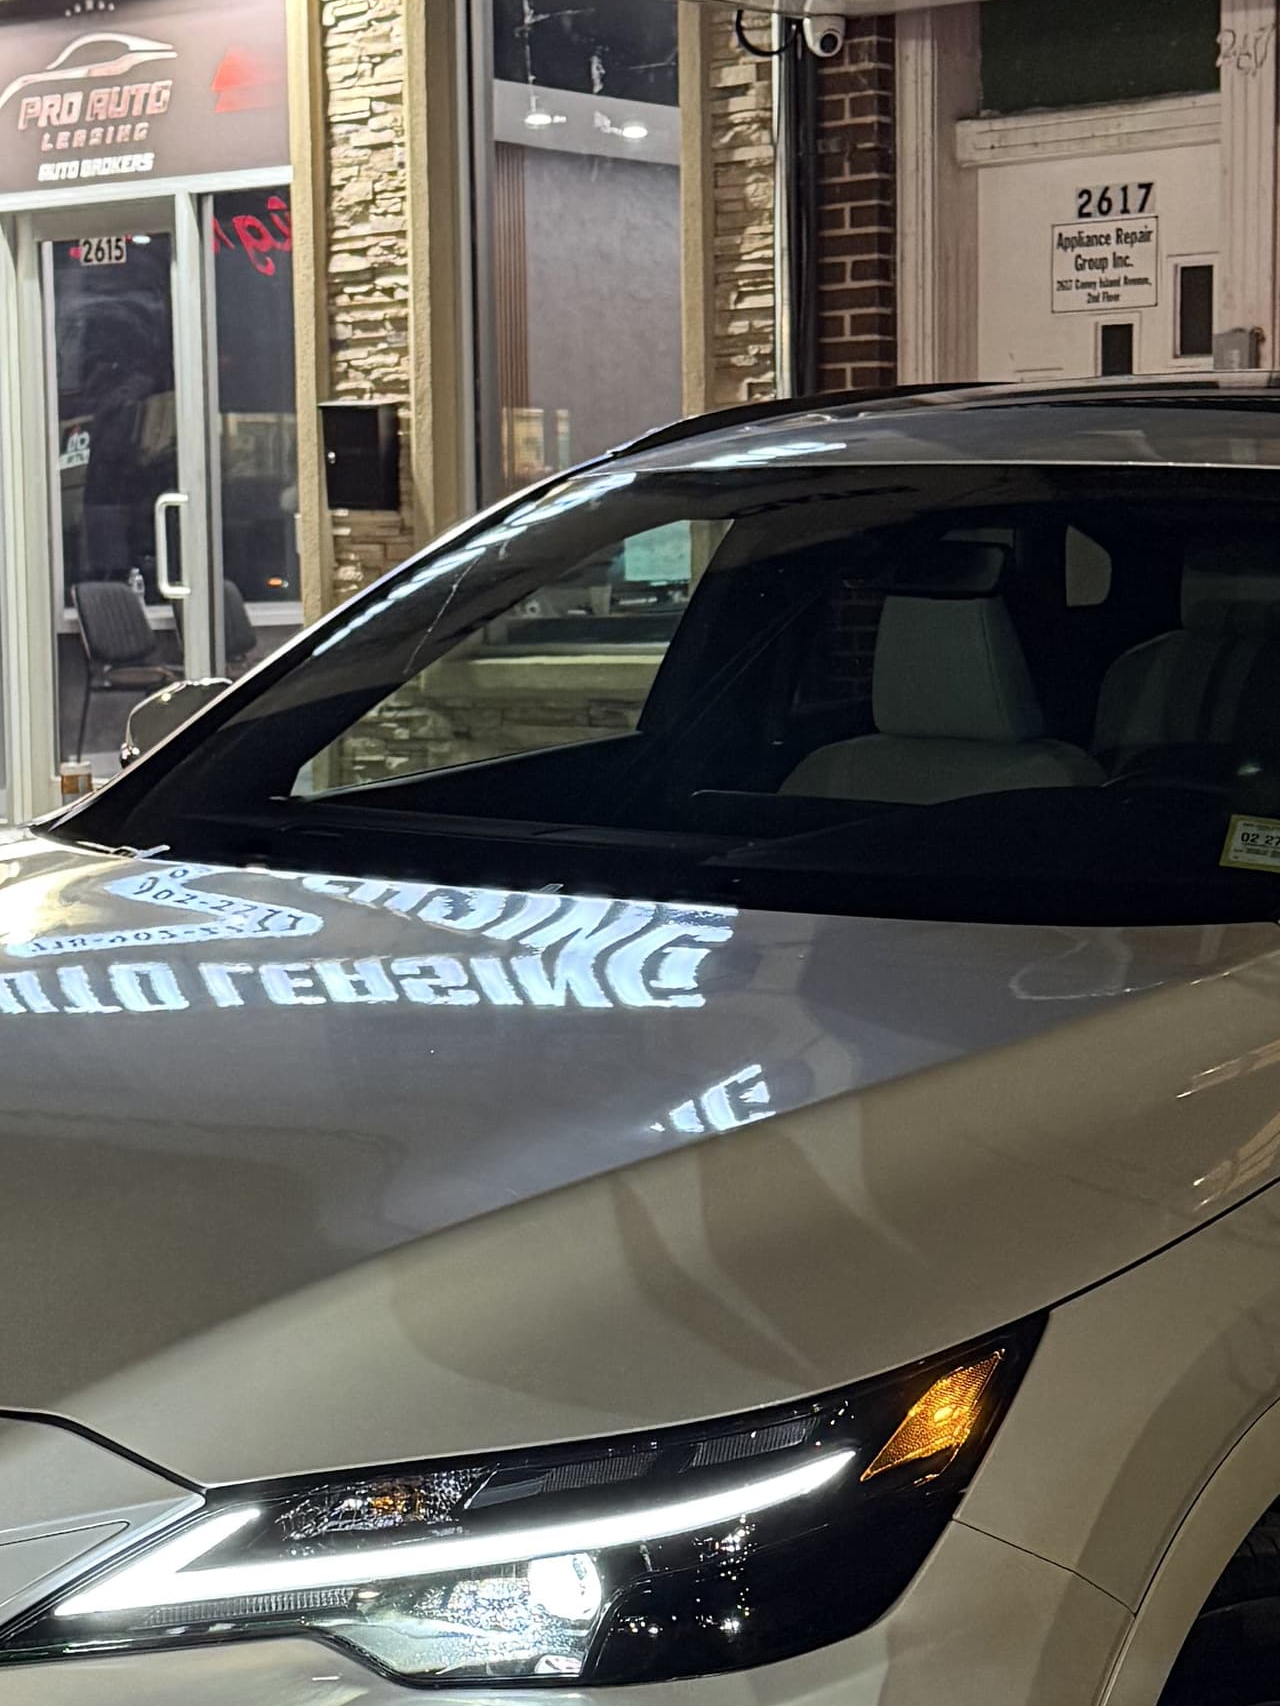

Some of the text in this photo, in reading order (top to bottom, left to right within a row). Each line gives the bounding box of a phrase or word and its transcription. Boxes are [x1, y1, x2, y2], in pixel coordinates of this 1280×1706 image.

[18, 80, 172, 130] PRO AUTO
[41, 122, 149, 151] LEASING
[1078, 182, 1154, 218] 2617
[83, 239, 124, 263] 2615
[1056, 225, 1153, 252] Appliance Repair
[1075, 252, 1134, 273] Group Inc.
[1241, 832, 1260, 844] 02
